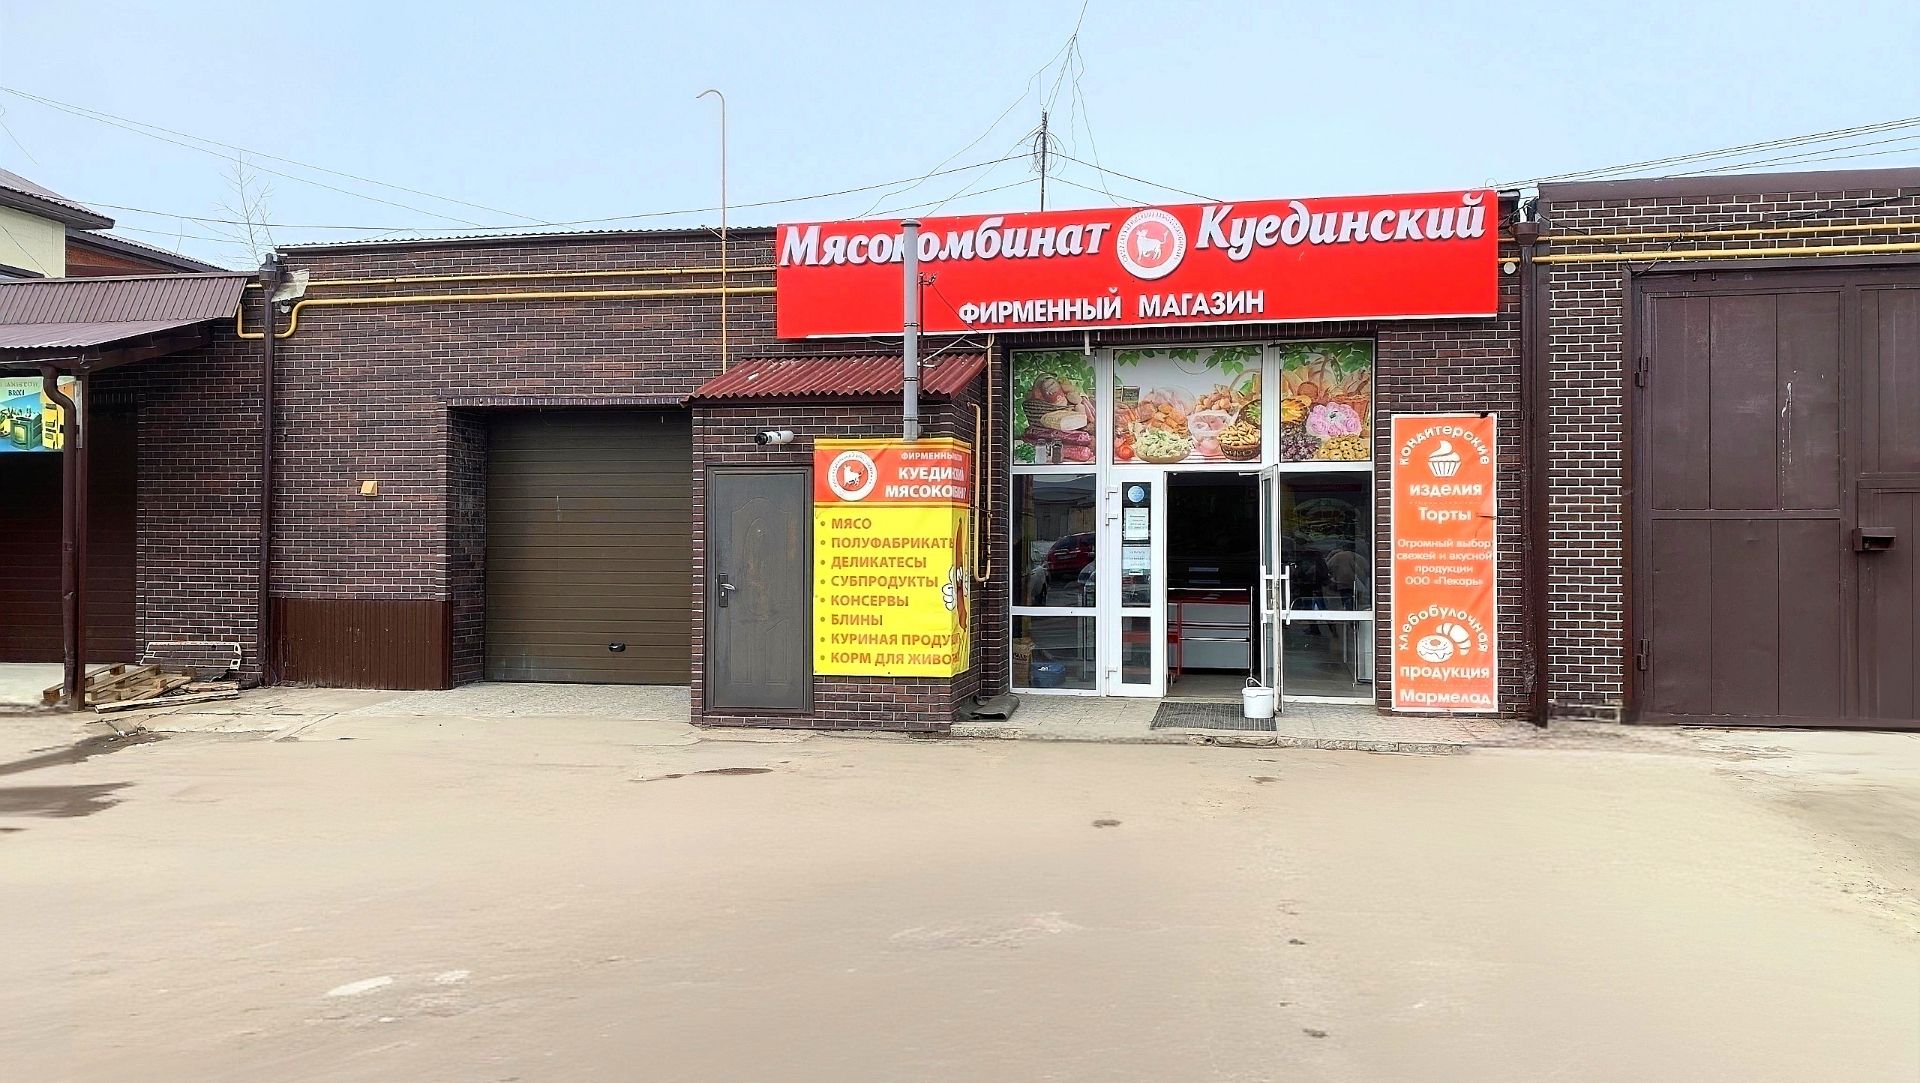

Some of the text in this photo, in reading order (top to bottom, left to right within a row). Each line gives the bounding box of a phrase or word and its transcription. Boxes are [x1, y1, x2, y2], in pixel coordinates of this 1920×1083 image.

[1194, 192, 1486, 262] Куединский
[958, 287, 1264, 324] ФИРМЕННЫЙ МАГАЗИН
[1409, 484, 1483, 498] изделия
[1418, 506, 1472, 524] Торты
[831, 518, 872, 530] МЯСО
[1397, 538, 1491, 549] Огромный выбор
[831, 556, 927, 569] ДЕЛИКАТЕСЫ
[1396, 551, 1492, 561] свежей и вкусной
[1414, 565, 1474, 575] продукции
[831, 575, 939, 589] СУБПРОДУКТЫ
[1405, 576, 1431, 585] ООО
[831, 595, 909, 607] КОНСЕРВЫ
[831, 614, 883, 626] БЛИНЫ
[831, 634, 898, 645] КУРИНАЯ
[831, 653, 872, 665] КОРМ
[875, 653, 905, 666] ДЛЯ
[1400, 666, 1490, 681] продукция
[1399, 688, 1491, 705] Мармелад
